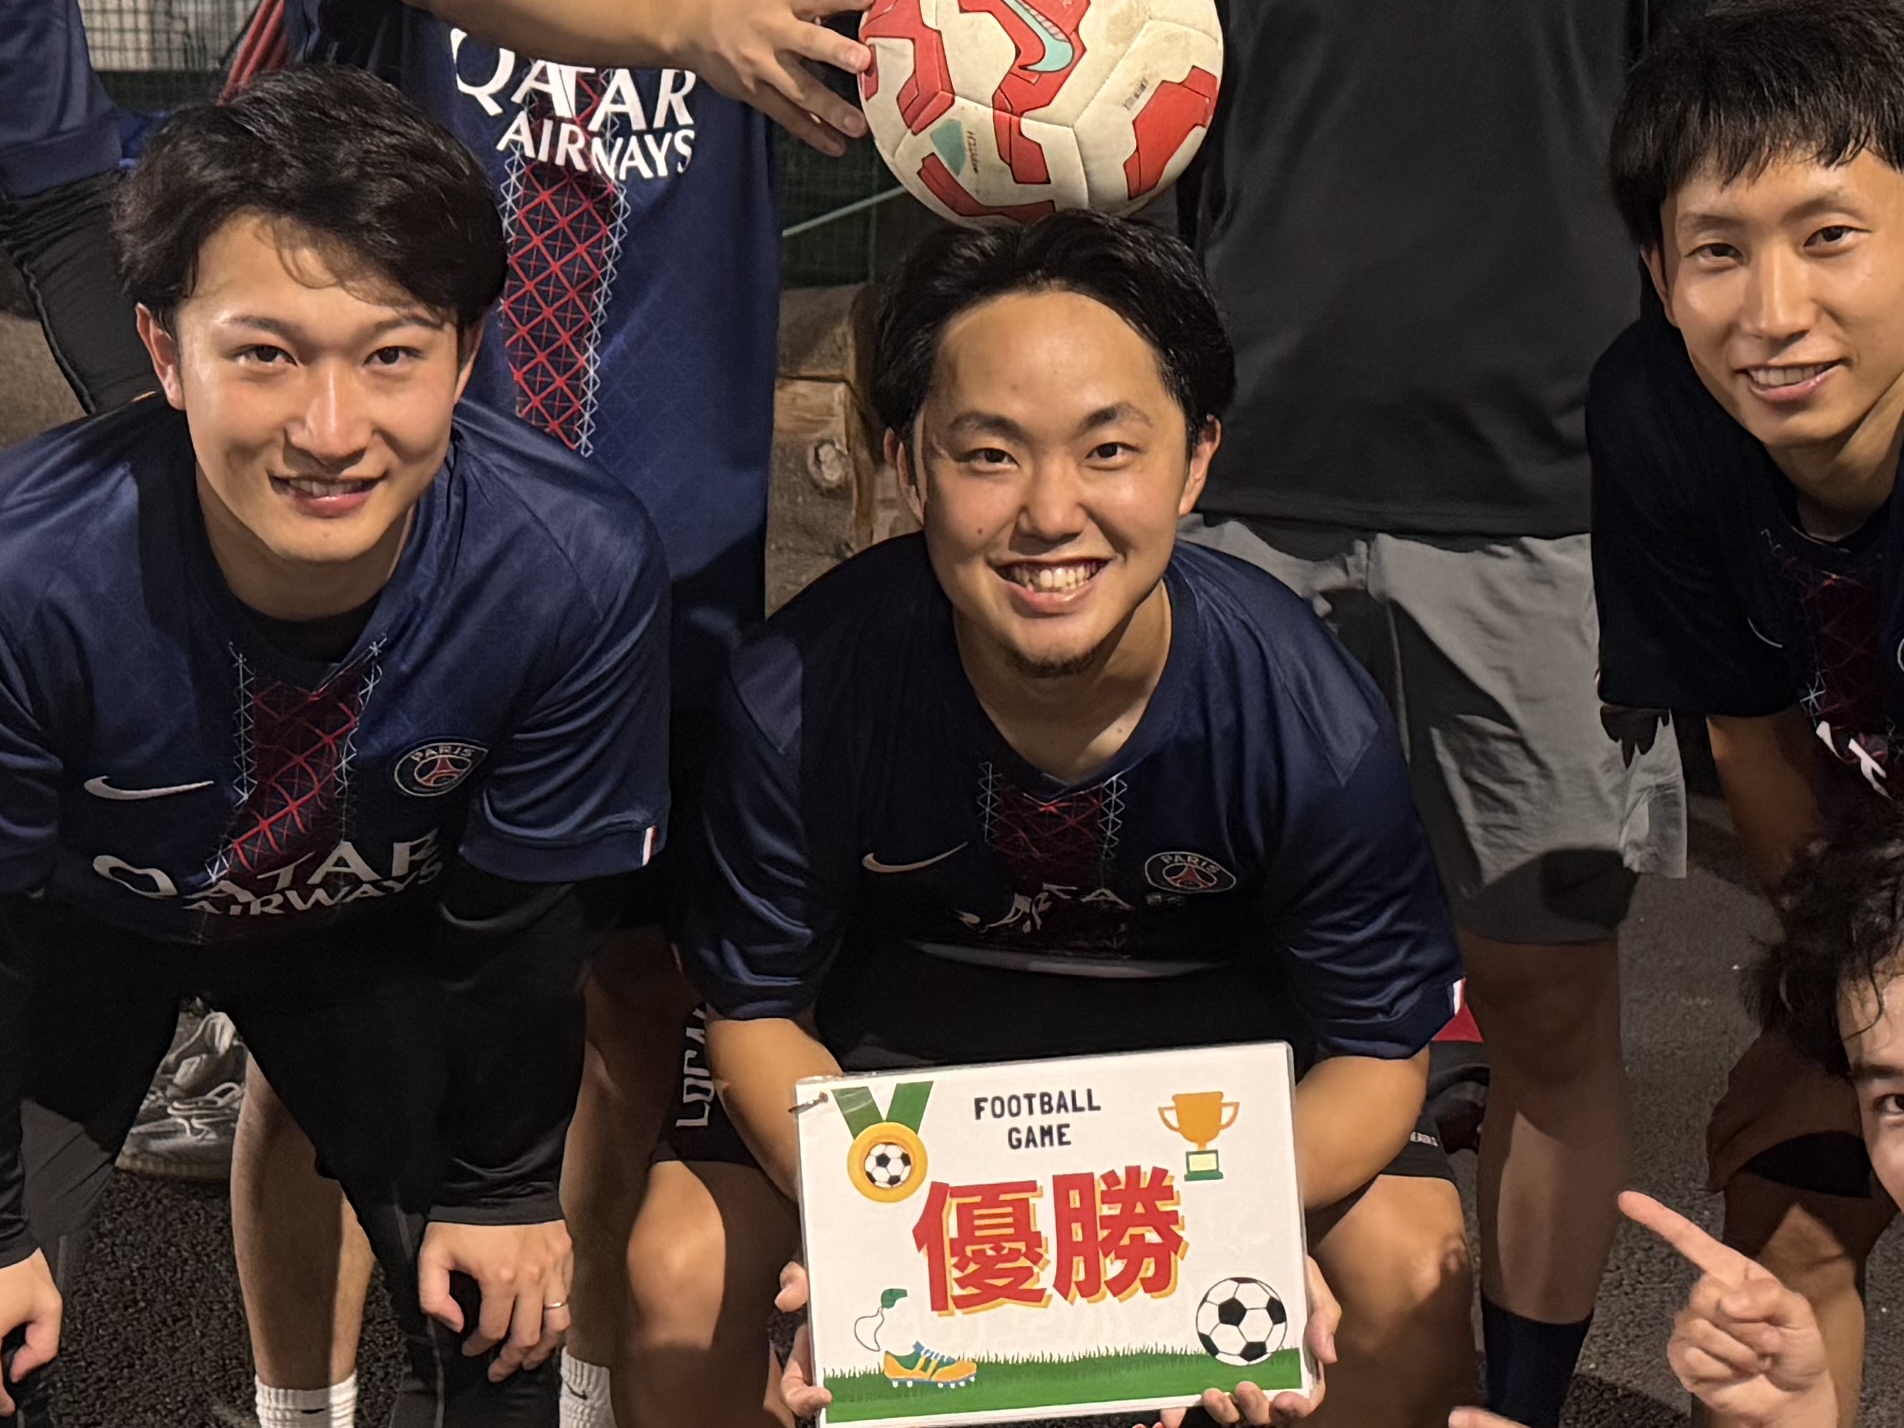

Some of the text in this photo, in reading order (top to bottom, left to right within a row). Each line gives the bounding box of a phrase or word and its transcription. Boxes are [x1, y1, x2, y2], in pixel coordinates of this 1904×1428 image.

[410, 745, 475, 762] PARIS
[1160, 855, 1220, 874] PARIS
[973, 1088, 1102, 1120] FOOTBALL
[1007, 1123, 1072, 1150] GAME
[912, 1164, 1189, 1317] 優勝
